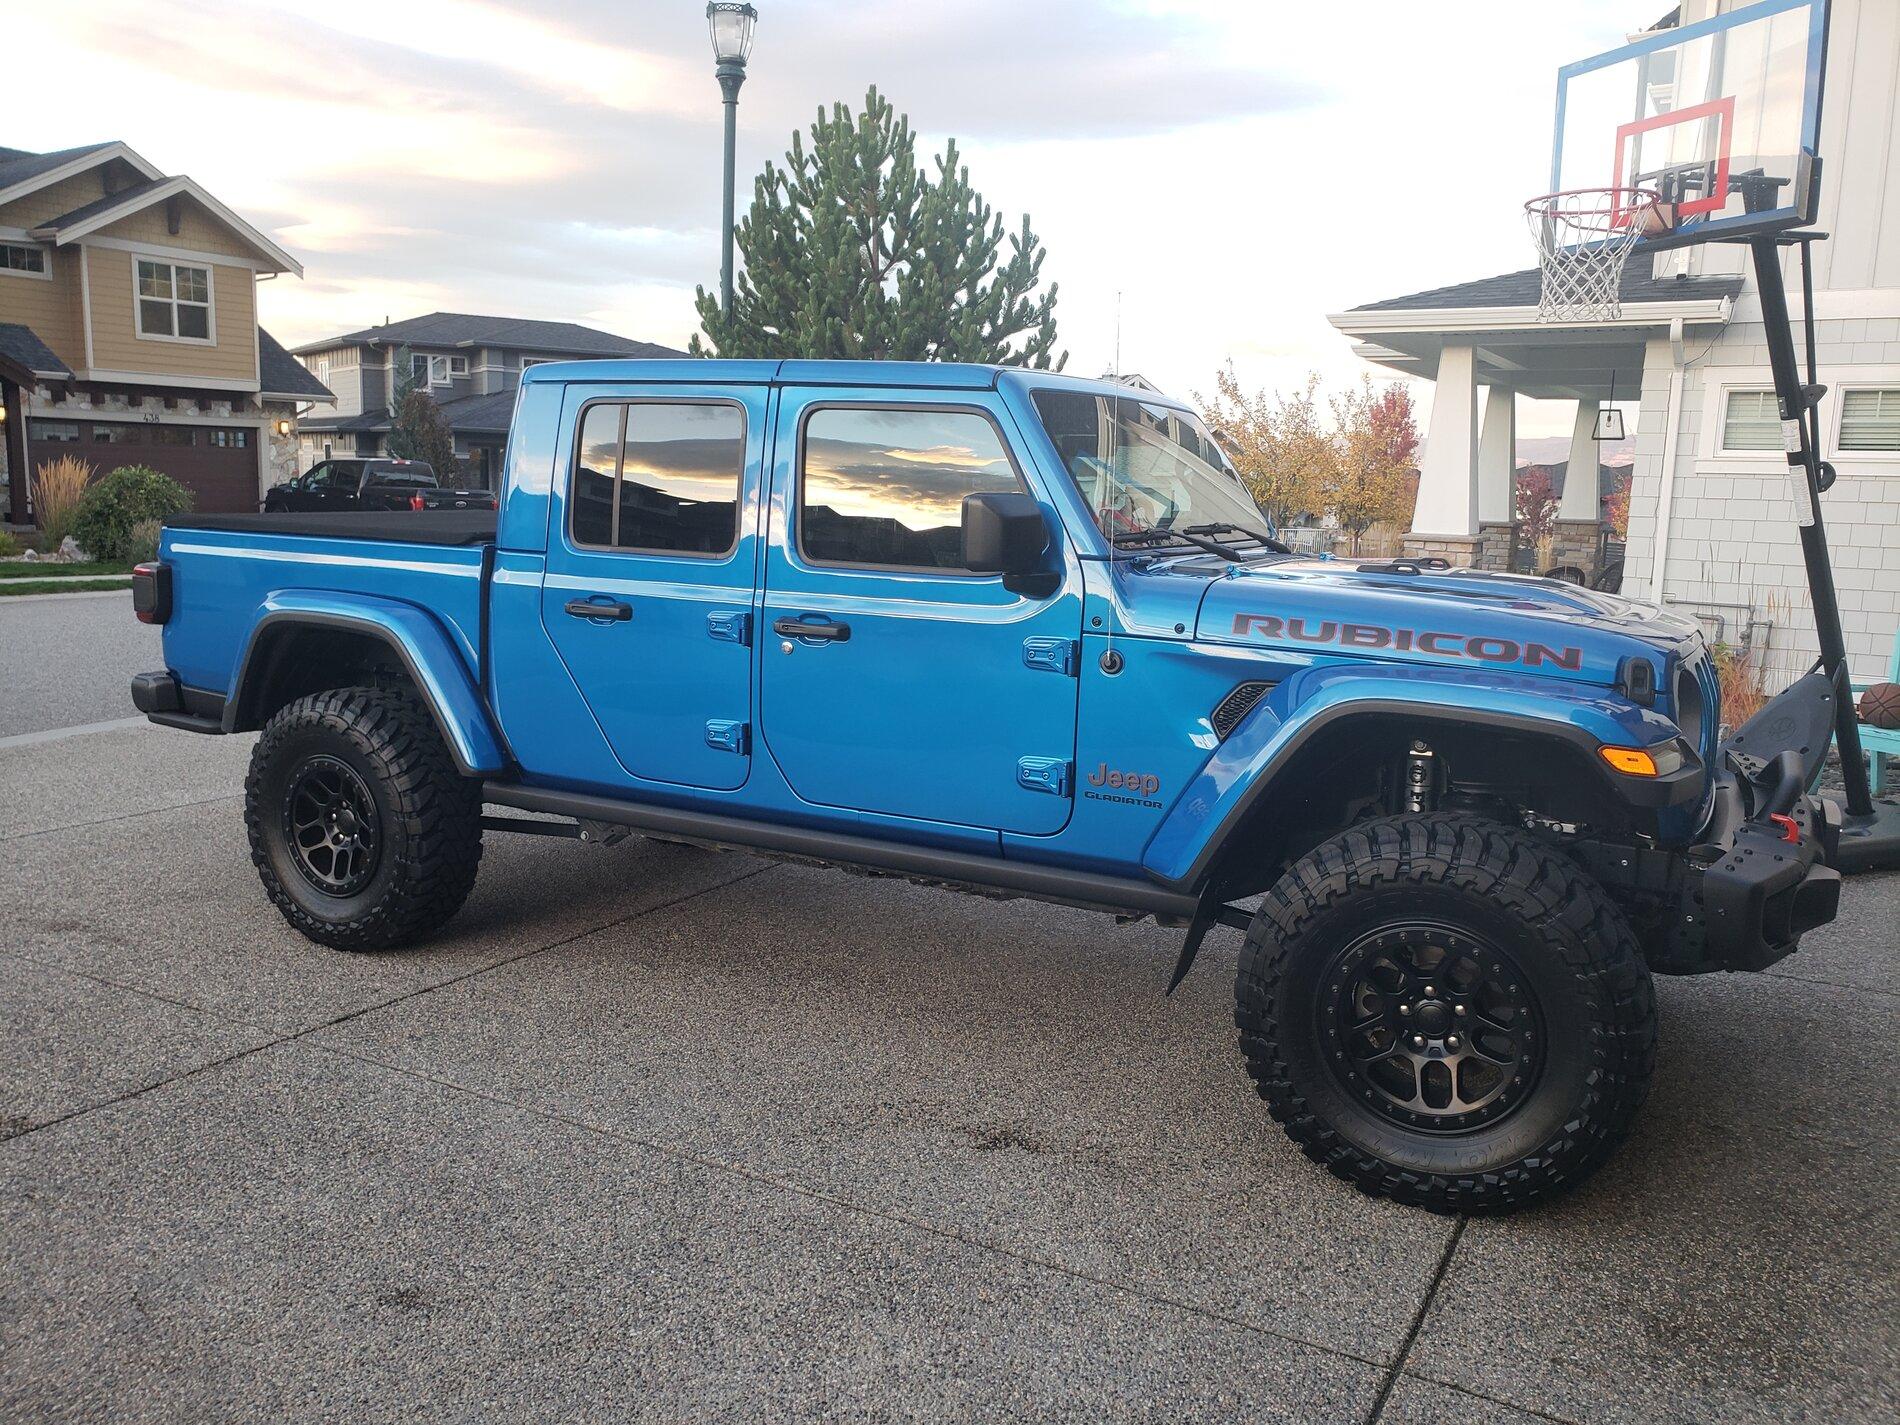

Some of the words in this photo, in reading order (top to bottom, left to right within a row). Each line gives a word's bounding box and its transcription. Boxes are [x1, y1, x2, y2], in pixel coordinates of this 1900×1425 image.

[143, 412, 160, 423] 438
[1232, 613, 1583, 671] RUBICON
[1088, 762, 1160, 797] Jeep
[1084, 791, 1163, 809] GLADIATOR
